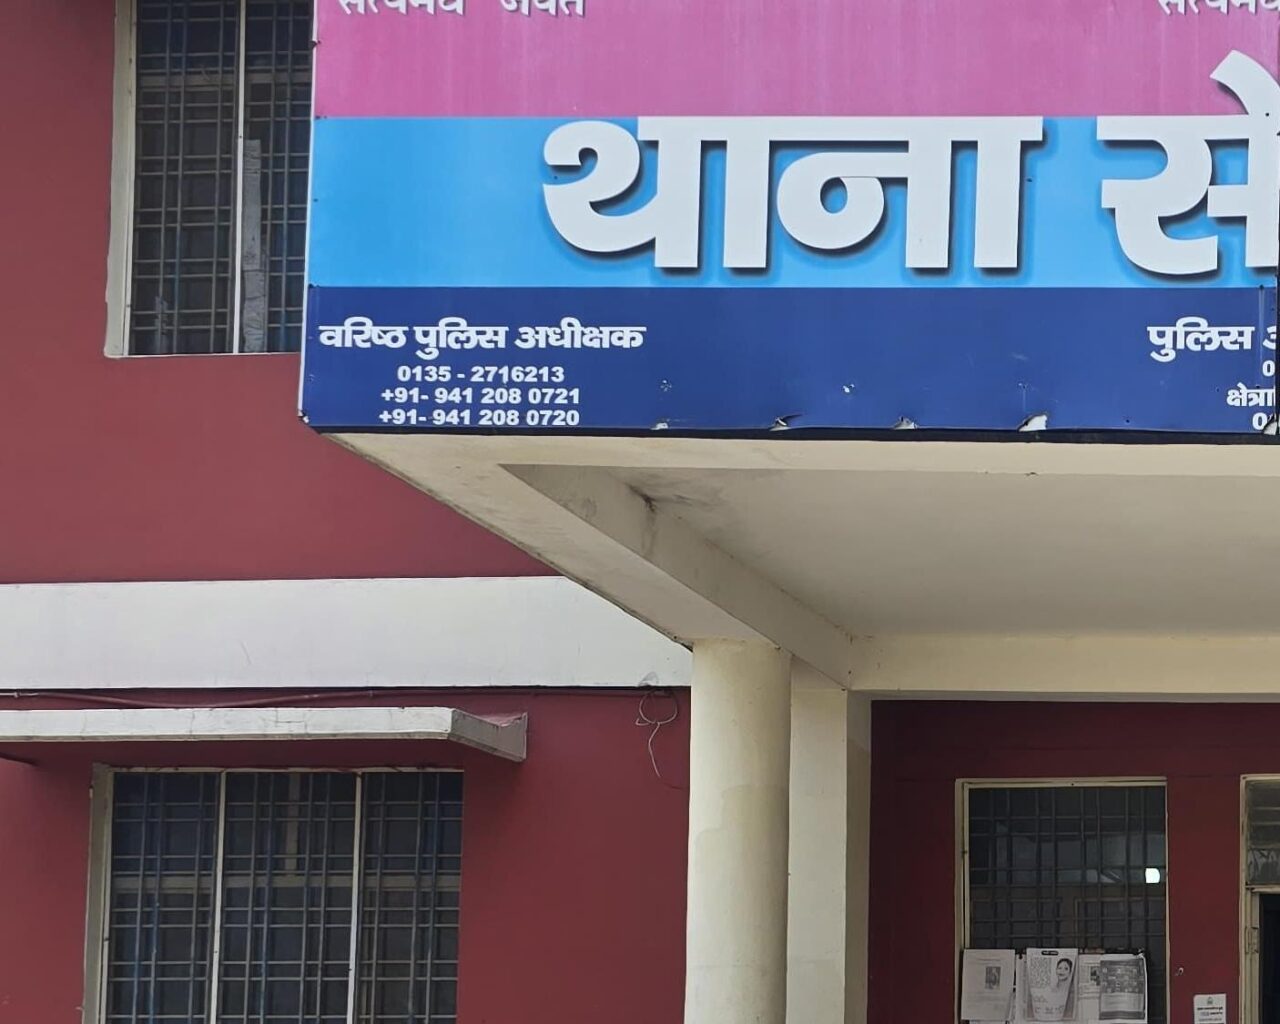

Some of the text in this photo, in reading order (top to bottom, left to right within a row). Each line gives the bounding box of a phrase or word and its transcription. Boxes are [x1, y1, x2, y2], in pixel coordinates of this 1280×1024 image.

[542, 116, 1045, 269] थाना
[318, 316, 647, 360] वरिष्ठ पुलिस अधीक्षक
[1146, 316, 1255, 362] पुलिस
[397, 366, 451, 382] 0135
[471, 366, 565, 383] 2716213
[434, 388, 473, 403] 941
[481, 388, 522, 403] 208
[528, 388, 580, 404] 0721
[432, 410, 471, 425] 941
[478, 410, 520, 425] 208
[526, 410, 580, 425] 0720
